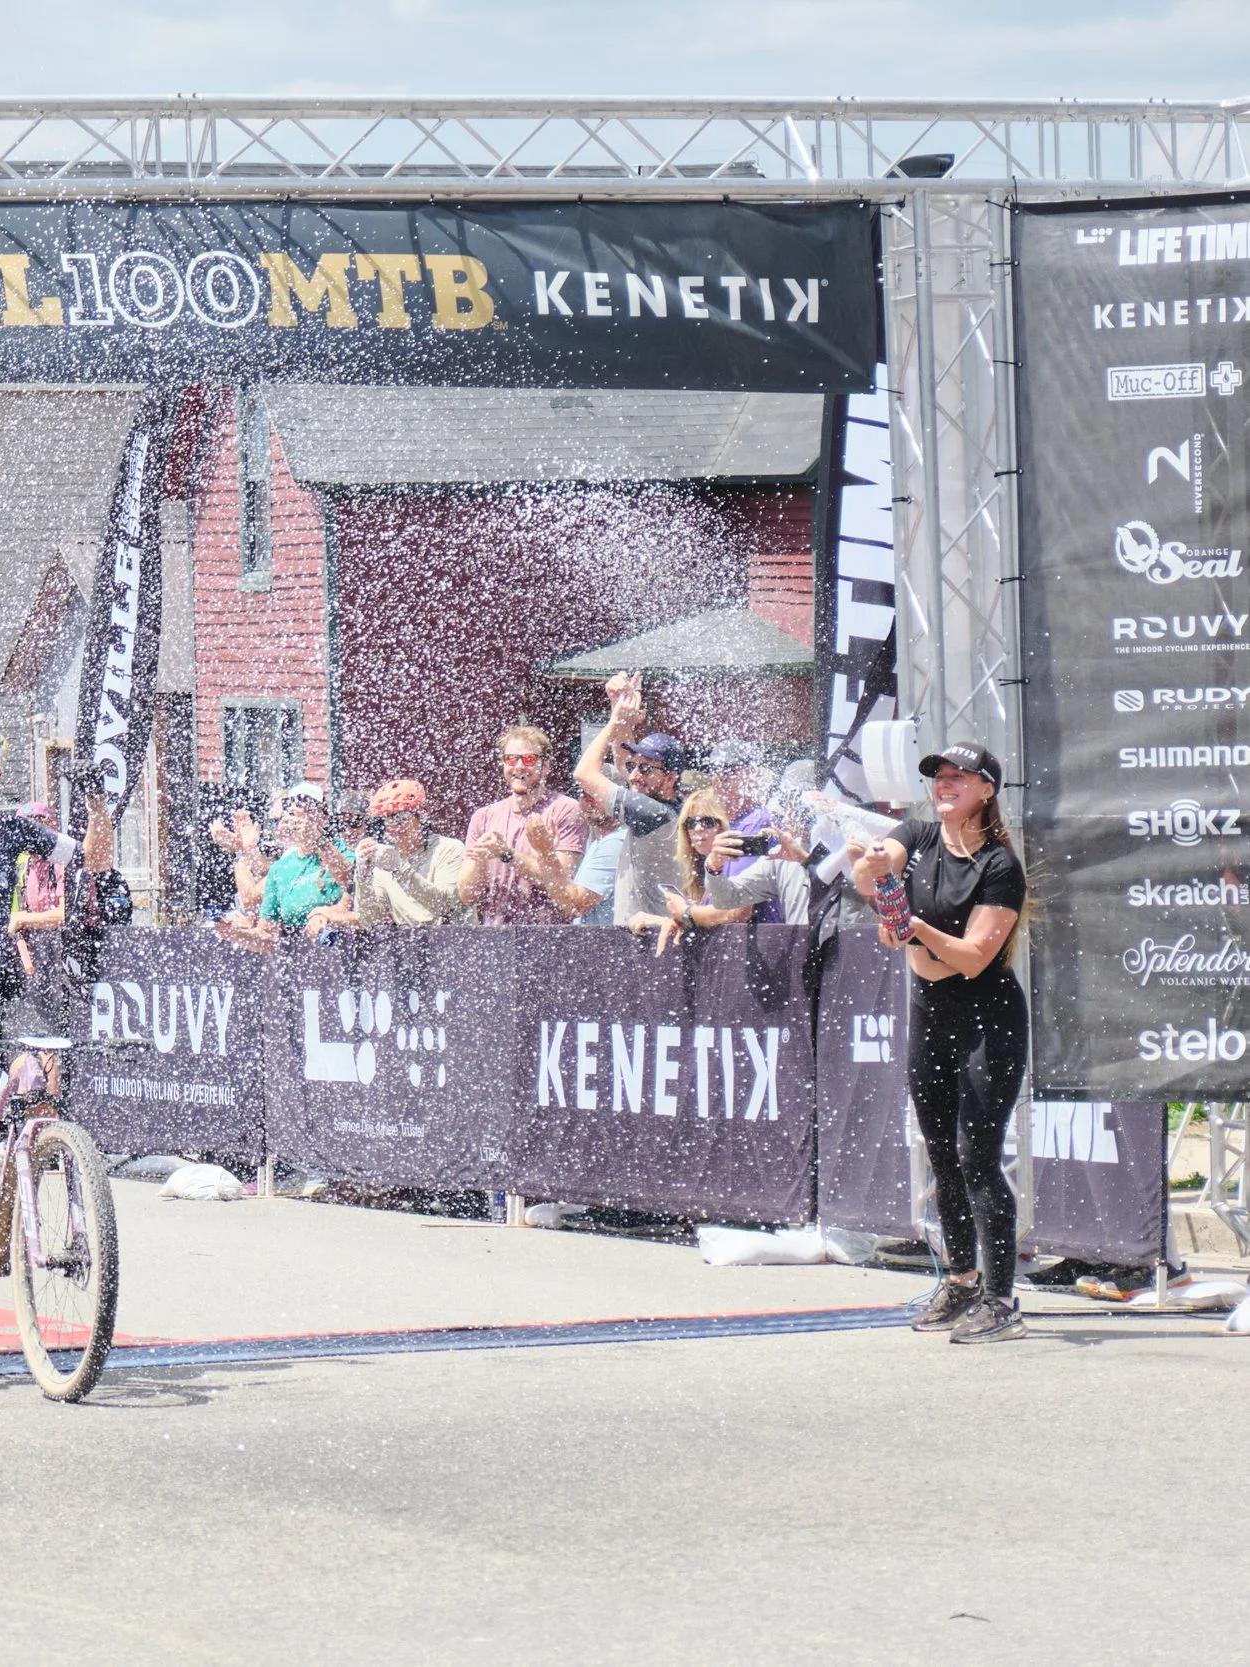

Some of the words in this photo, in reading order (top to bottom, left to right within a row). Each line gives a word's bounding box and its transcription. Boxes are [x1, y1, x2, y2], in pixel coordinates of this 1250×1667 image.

[1119, 222, 1250, 265] LIFETIM
[61, 250, 260, 328] 100
[259, 253, 495, 329] MTB
[534, 270, 819, 323] KENETIK
[1116, 370, 1199, 394] Muc-Off
[1195, 433, 1203, 513] NEVERSECOND
[1146, 542, 1243, 584] Seal
[1186, 548, 1229, 557] ORANGE
[1114, 614, 1249, 640] ROUVY
[1165, 644, 1198, 652] CYCLING
[1153, 687, 1250, 704] RUDY
[1161, 703, 1247, 711] PROJECT
[1119, 745, 1250, 768] SHIMANO
[1128, 809, 1241, 836] SHOKZ
[1128, 878, 1239, 906] skratch
[1240, 883, 1250, 905] LABS
[1160, 977, 1216, 986] VOLCANIC
[1220, 976, 1250, 985] WATE
[92, 982, 235, 1056] ROUVY
[1138, 1018, 1246, 1062] stelo
[538, 1021, 779, 1120] KENETIK
[93, 1077, 108, 1095] THE
